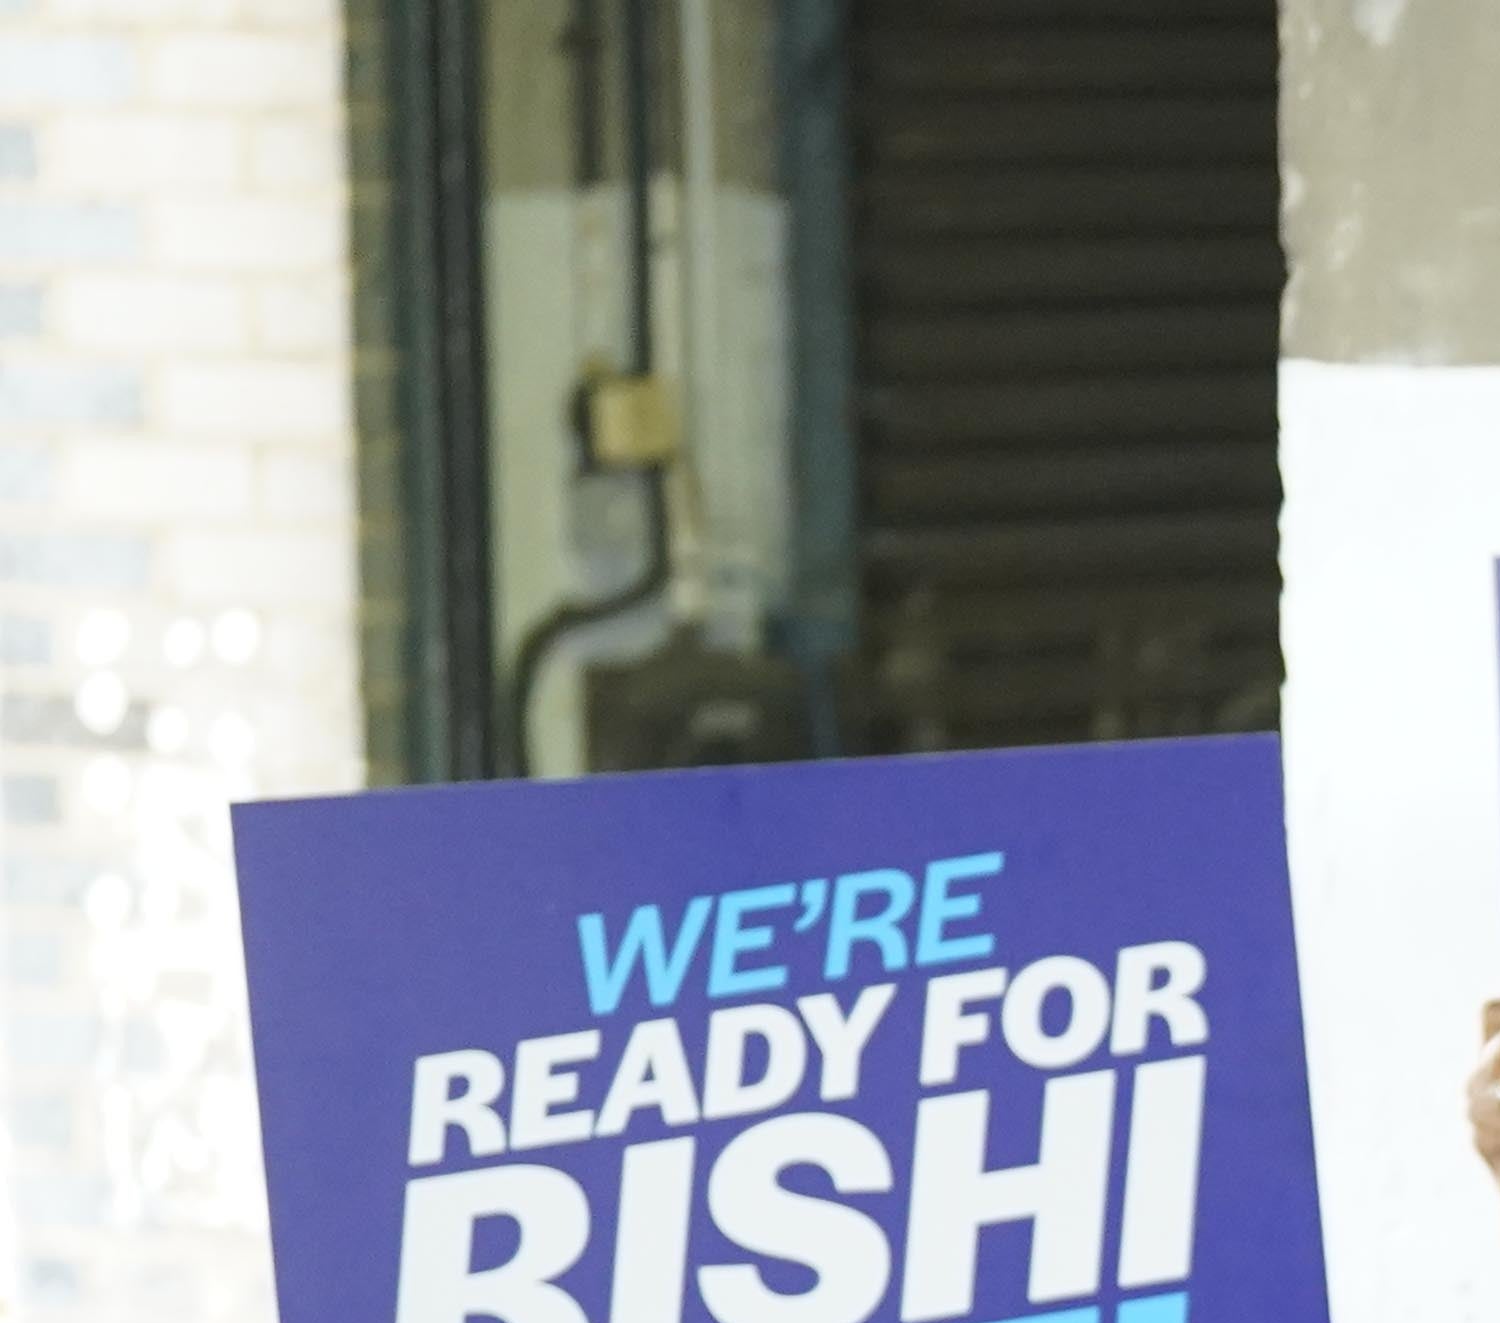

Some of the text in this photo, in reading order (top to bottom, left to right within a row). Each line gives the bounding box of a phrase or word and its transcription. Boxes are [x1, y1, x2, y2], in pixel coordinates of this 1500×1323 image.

[577, 852, 1004, 1016] WE'RE
[408, 941, 1208, 1166] READY FOR
